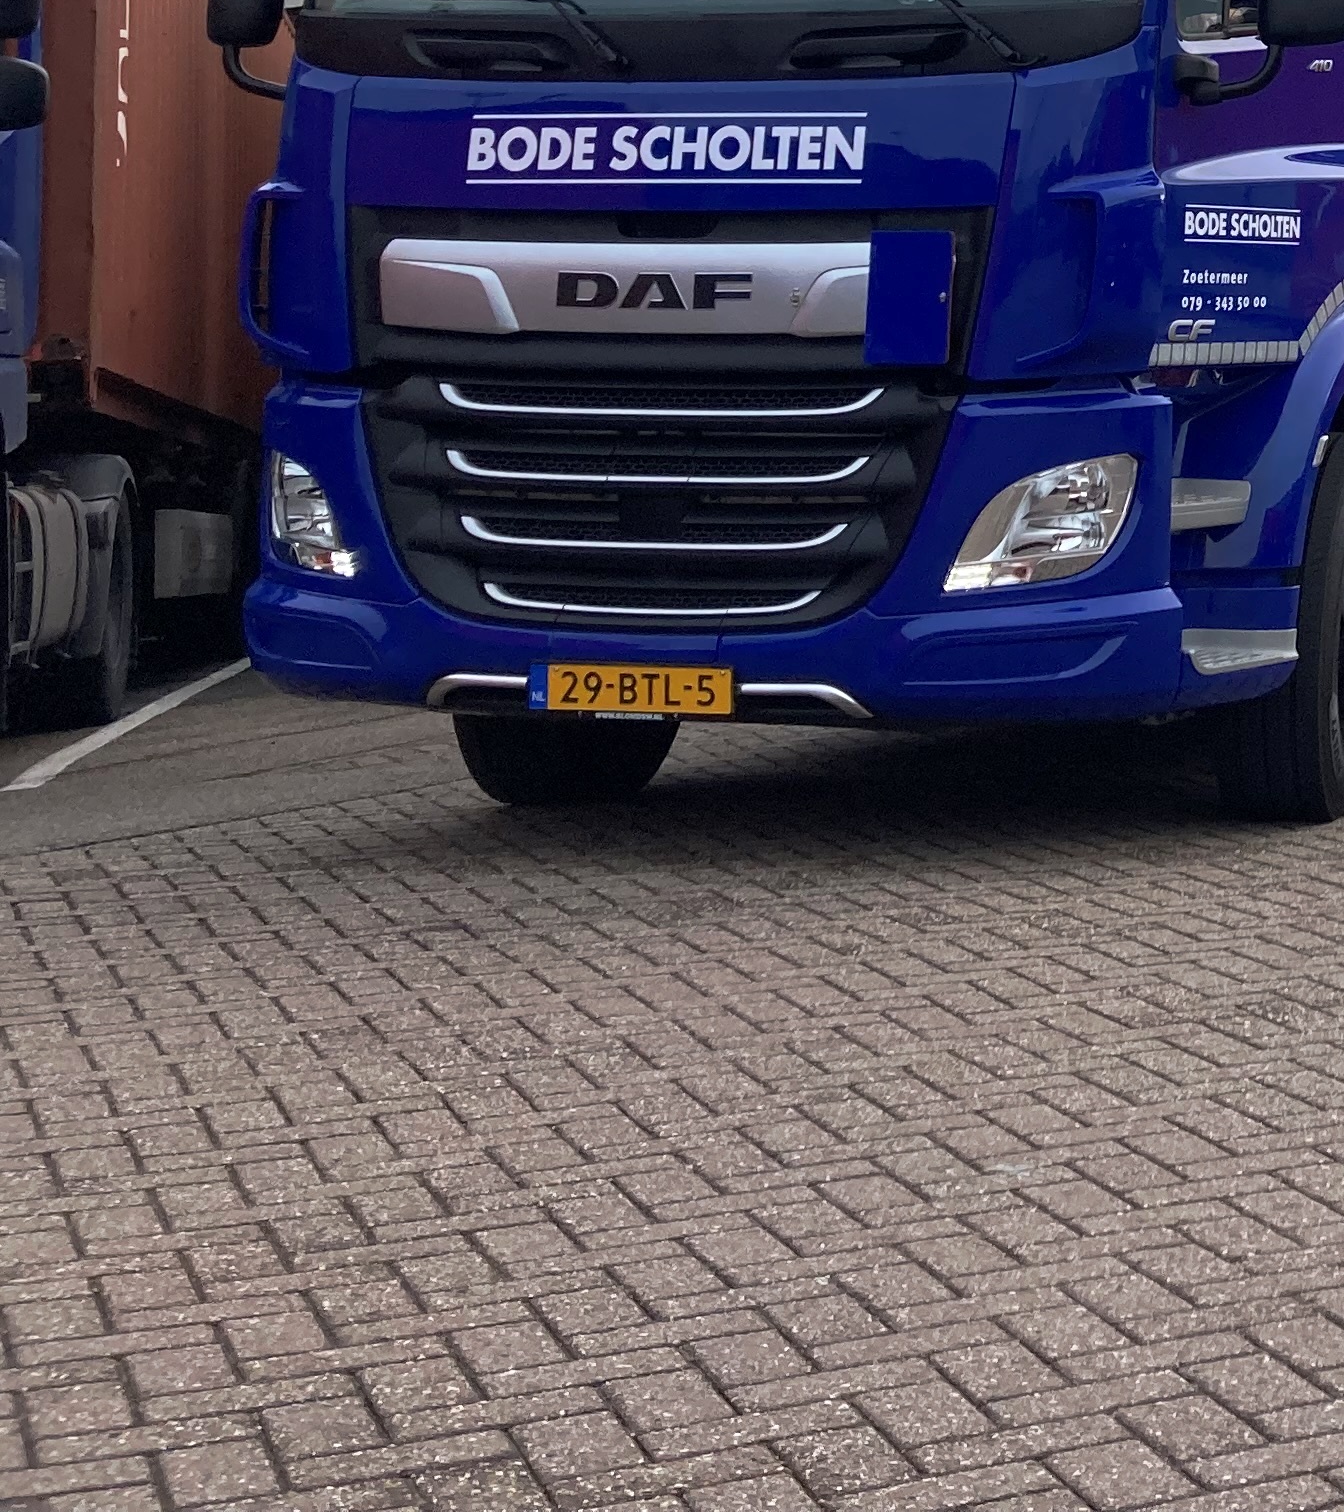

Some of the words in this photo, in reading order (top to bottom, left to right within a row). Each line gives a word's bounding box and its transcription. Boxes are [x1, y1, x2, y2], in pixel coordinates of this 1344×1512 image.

[1308, 59, 1333, 72] 410
[467, 126, 598, 172] BODE
[609, 125, 867, 172] SCHOLTEN
[1184, 211, 1228, 236] BODE
[1230, 213, 1301, 239] SCHOLTEN
[1182, 269, 1248, 285] Zoetermeer
[556, 270, 754, 311] DAF
[1181, 296, 1203, 311] 079
[1214, 296, 1234, 311] 343
[1236, 296, 1250, 311] 50
[1253, 296, 1267, 308] 00
[1167, 319, 1216, 342] CF
[531, 691, 546, 702] NL
[559, 671, 716, 707] 29-BTL-5
